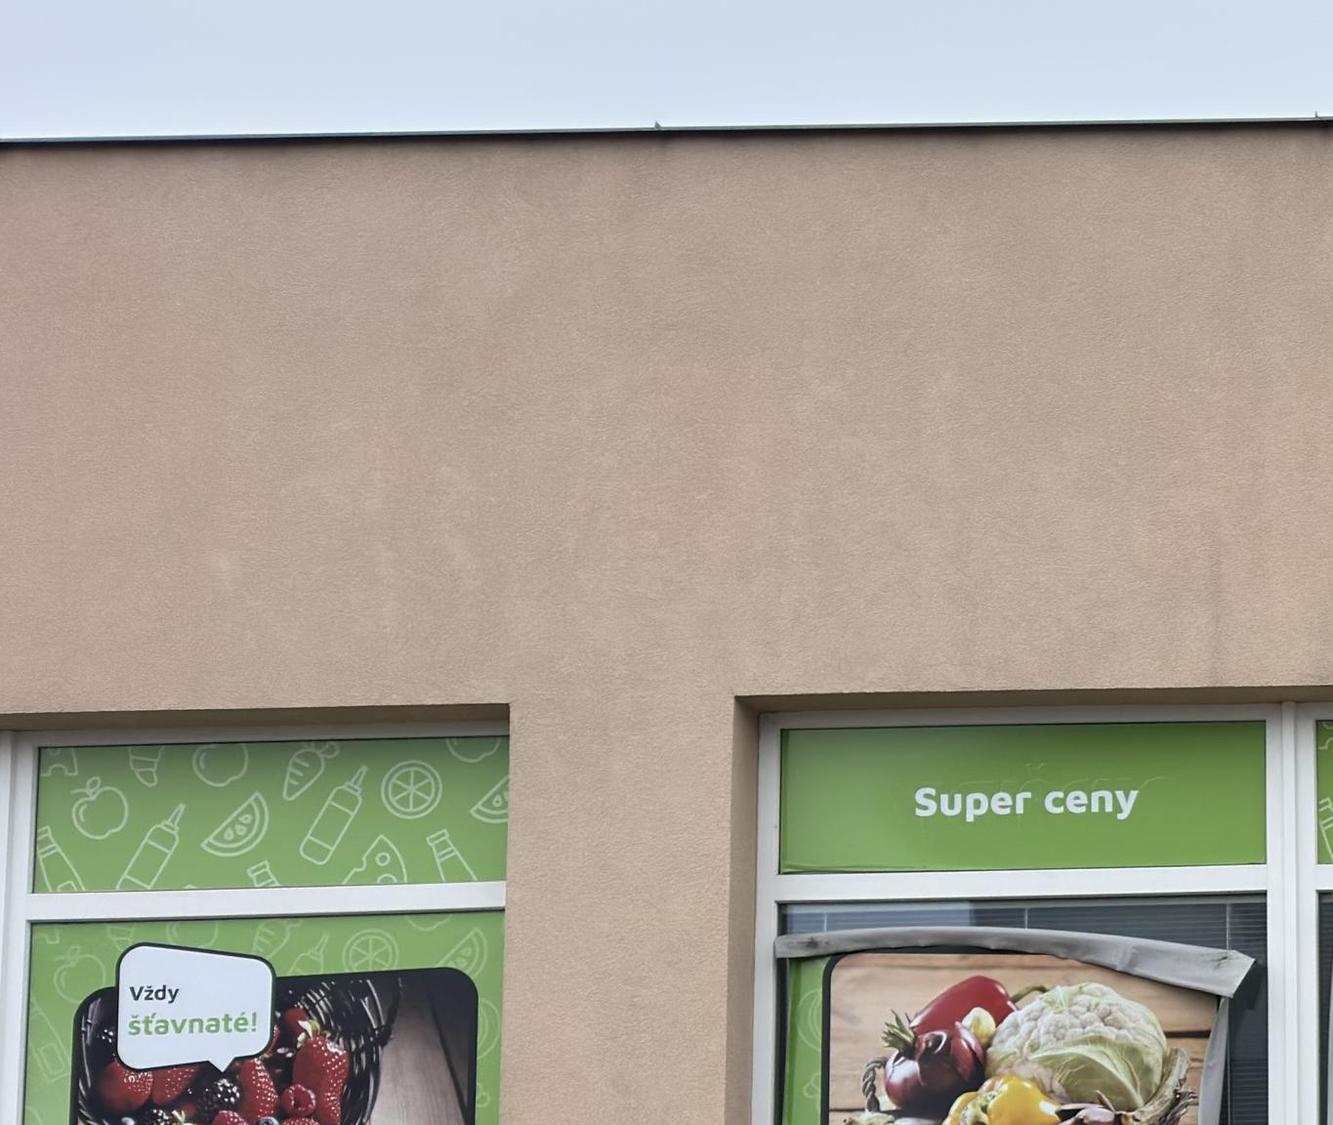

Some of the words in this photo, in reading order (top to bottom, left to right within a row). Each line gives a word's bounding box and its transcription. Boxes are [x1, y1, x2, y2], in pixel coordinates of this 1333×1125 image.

[915, 788, 1031, 822] Super
[1045, 790, 1138, 820] ceny
[129, 984, 180, 1005] Vždy
[128, 1011, 258, 1036] šťavnaté!
